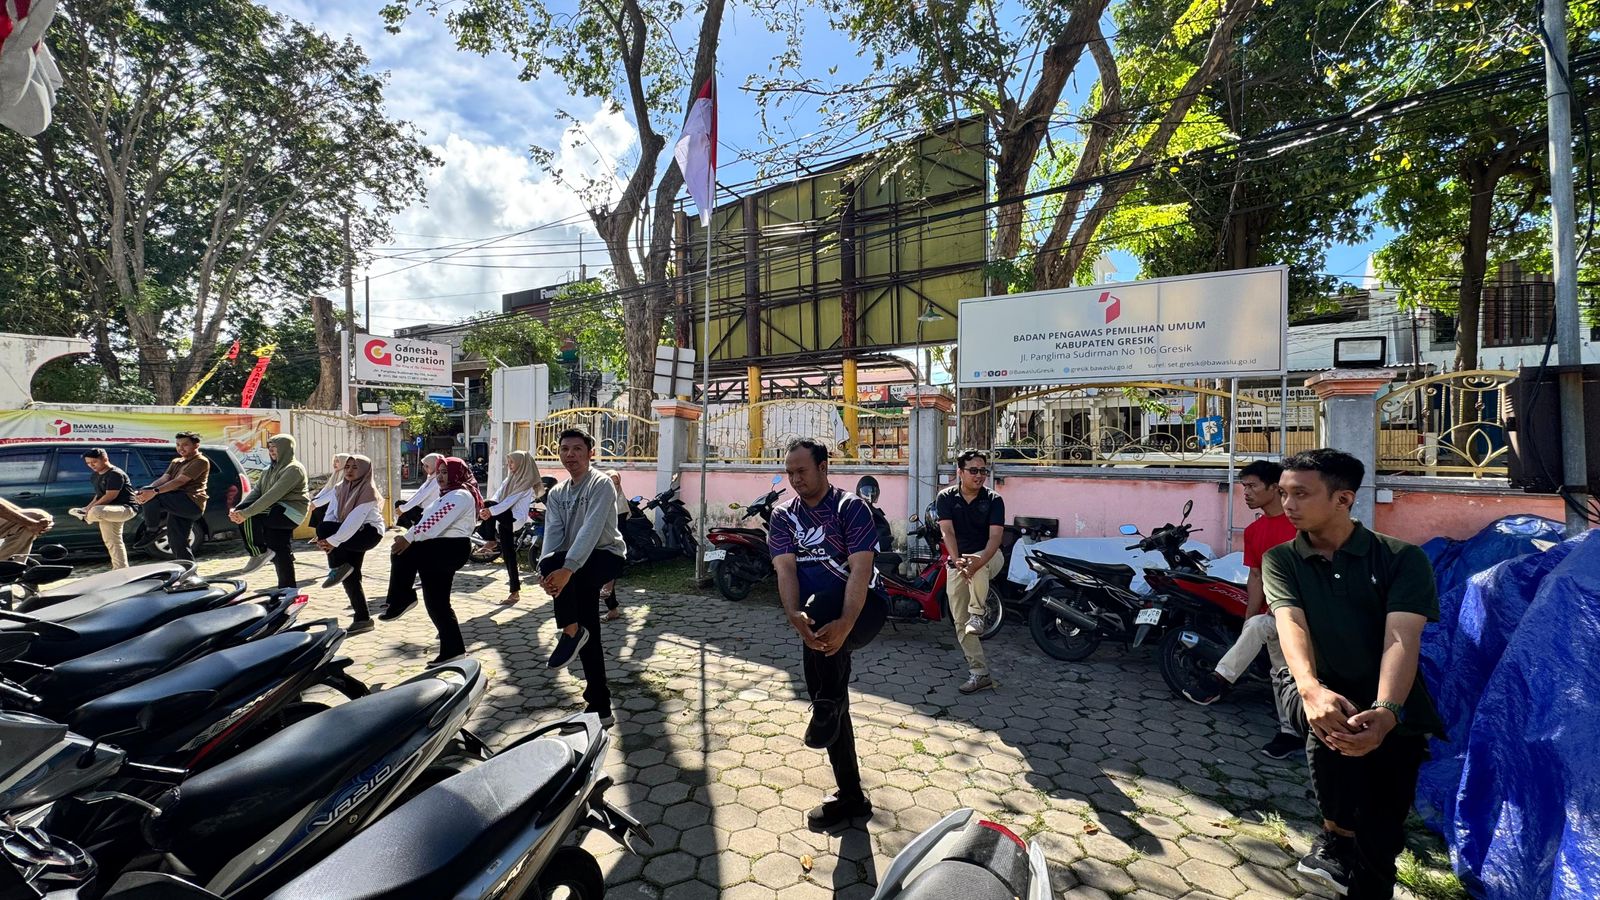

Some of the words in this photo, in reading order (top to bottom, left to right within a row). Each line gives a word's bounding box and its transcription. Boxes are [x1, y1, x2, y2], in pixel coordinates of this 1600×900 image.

[1013, 333, 1046, 342] BADAN
[1048, 328, 1103, 340] PENGAWAS
[1105, 324, 1165, 336] PEMILIHAN
[1168, 321, 1206, 331] UMUM
[395, 344, 438, 356] Ganesha
[1055, 338, 1114, 350] KABUPATEN
[1117, 336, 1154, 346] GRESIK
[395, 353, 445, 366] Operation
[1030, 352, 1071, 362] Panglima
[1073, 349, 1118, 359] Sudirman
[1121, 348, 1136, 356] No
[1139, 347, 1157, 355] 106
[1159, 344, 1193, 354] Gresik
[312, 765, 391, 826] VARIO
